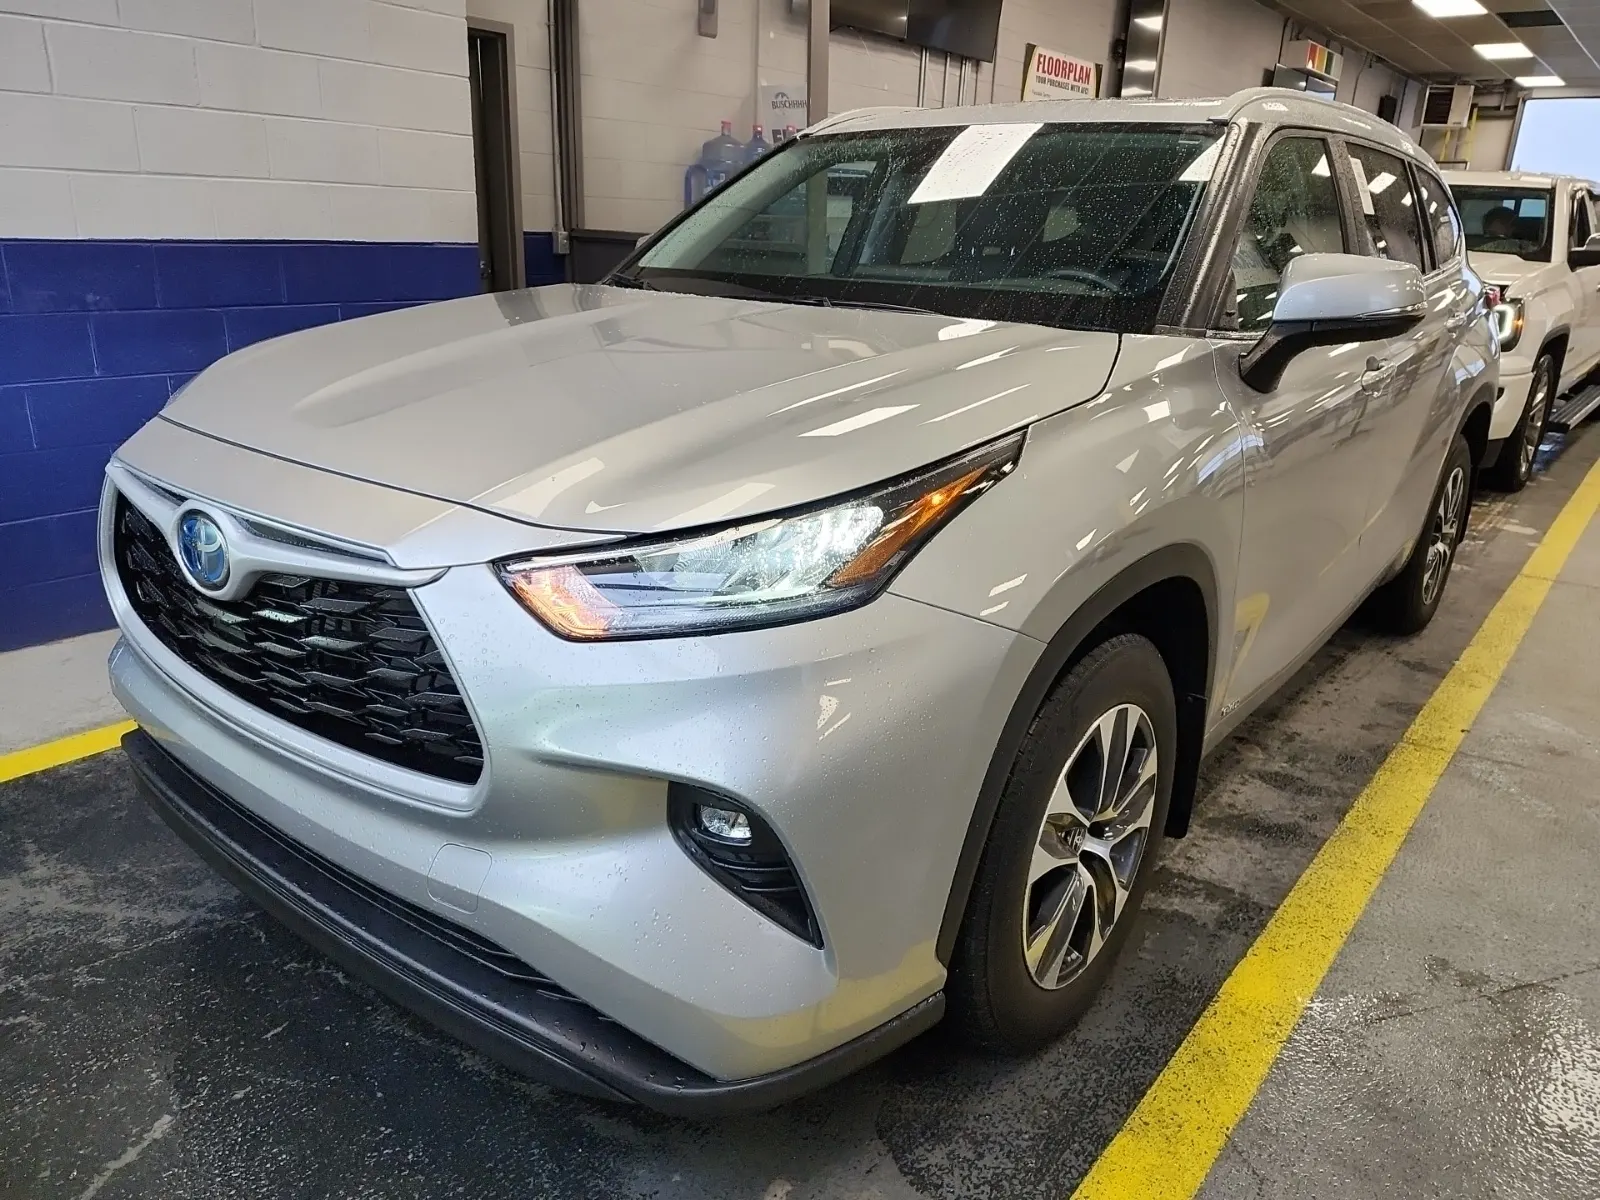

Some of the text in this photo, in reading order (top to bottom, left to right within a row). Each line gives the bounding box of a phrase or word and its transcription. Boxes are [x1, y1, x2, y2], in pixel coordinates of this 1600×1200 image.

[1036, 53, 1091, 85] FLOORPLAN
[1036, 75, 1047, 85] YOUR
[1047, 78, 1070, 91] PURCHASES
[1070, 84, 1081, 93] WITH
